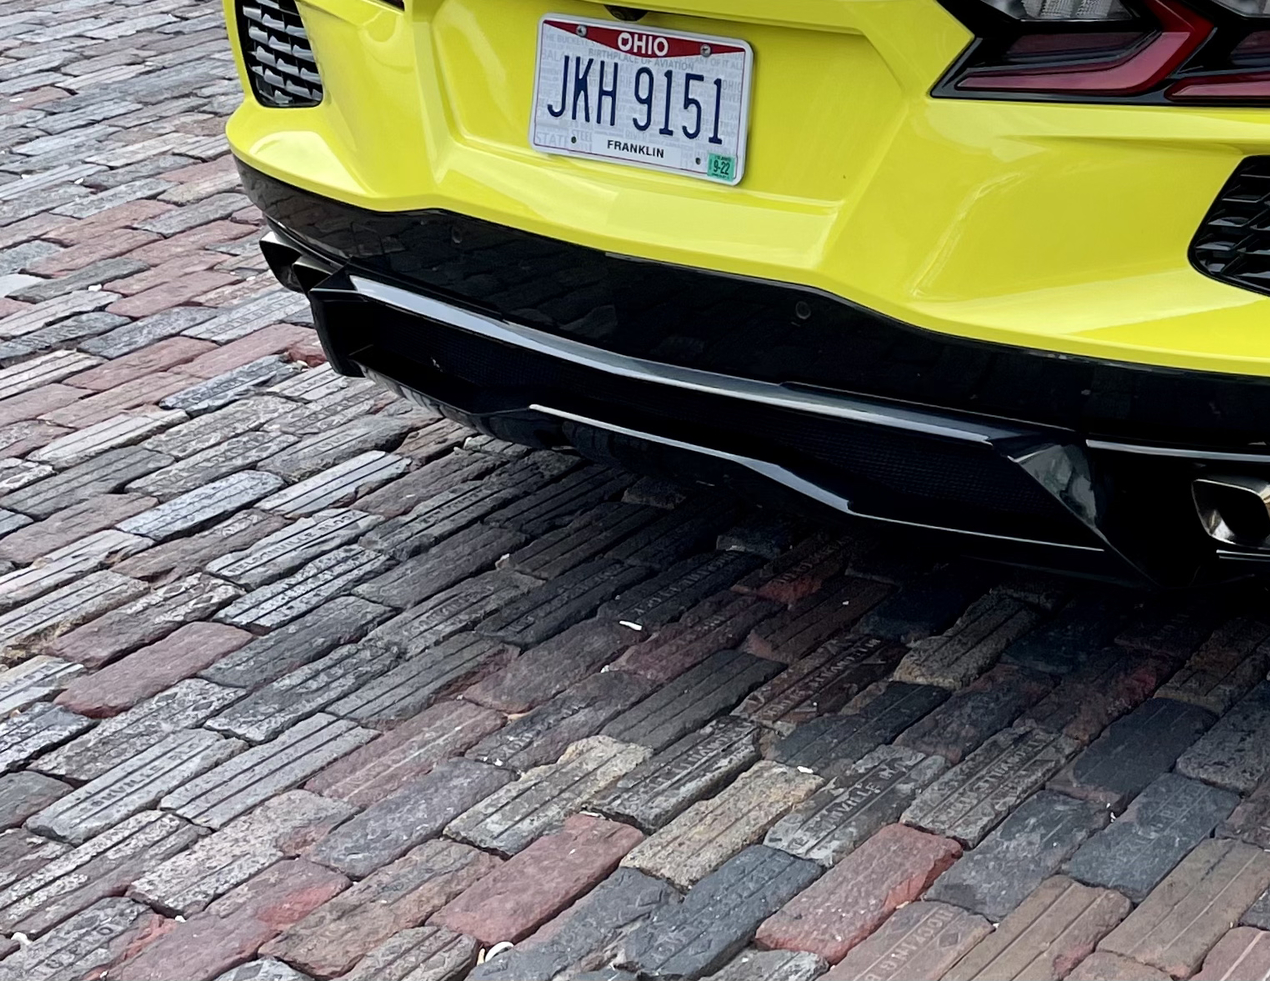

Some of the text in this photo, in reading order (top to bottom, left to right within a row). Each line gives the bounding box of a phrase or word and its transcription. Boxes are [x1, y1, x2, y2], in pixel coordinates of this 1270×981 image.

[617, 31, 669, 57] OHIO
[547, 54, 723, 146] JKH 9151
[607, 139, 665, 159] FRANKLIN
[713, 160, 731, 176] 9-22
